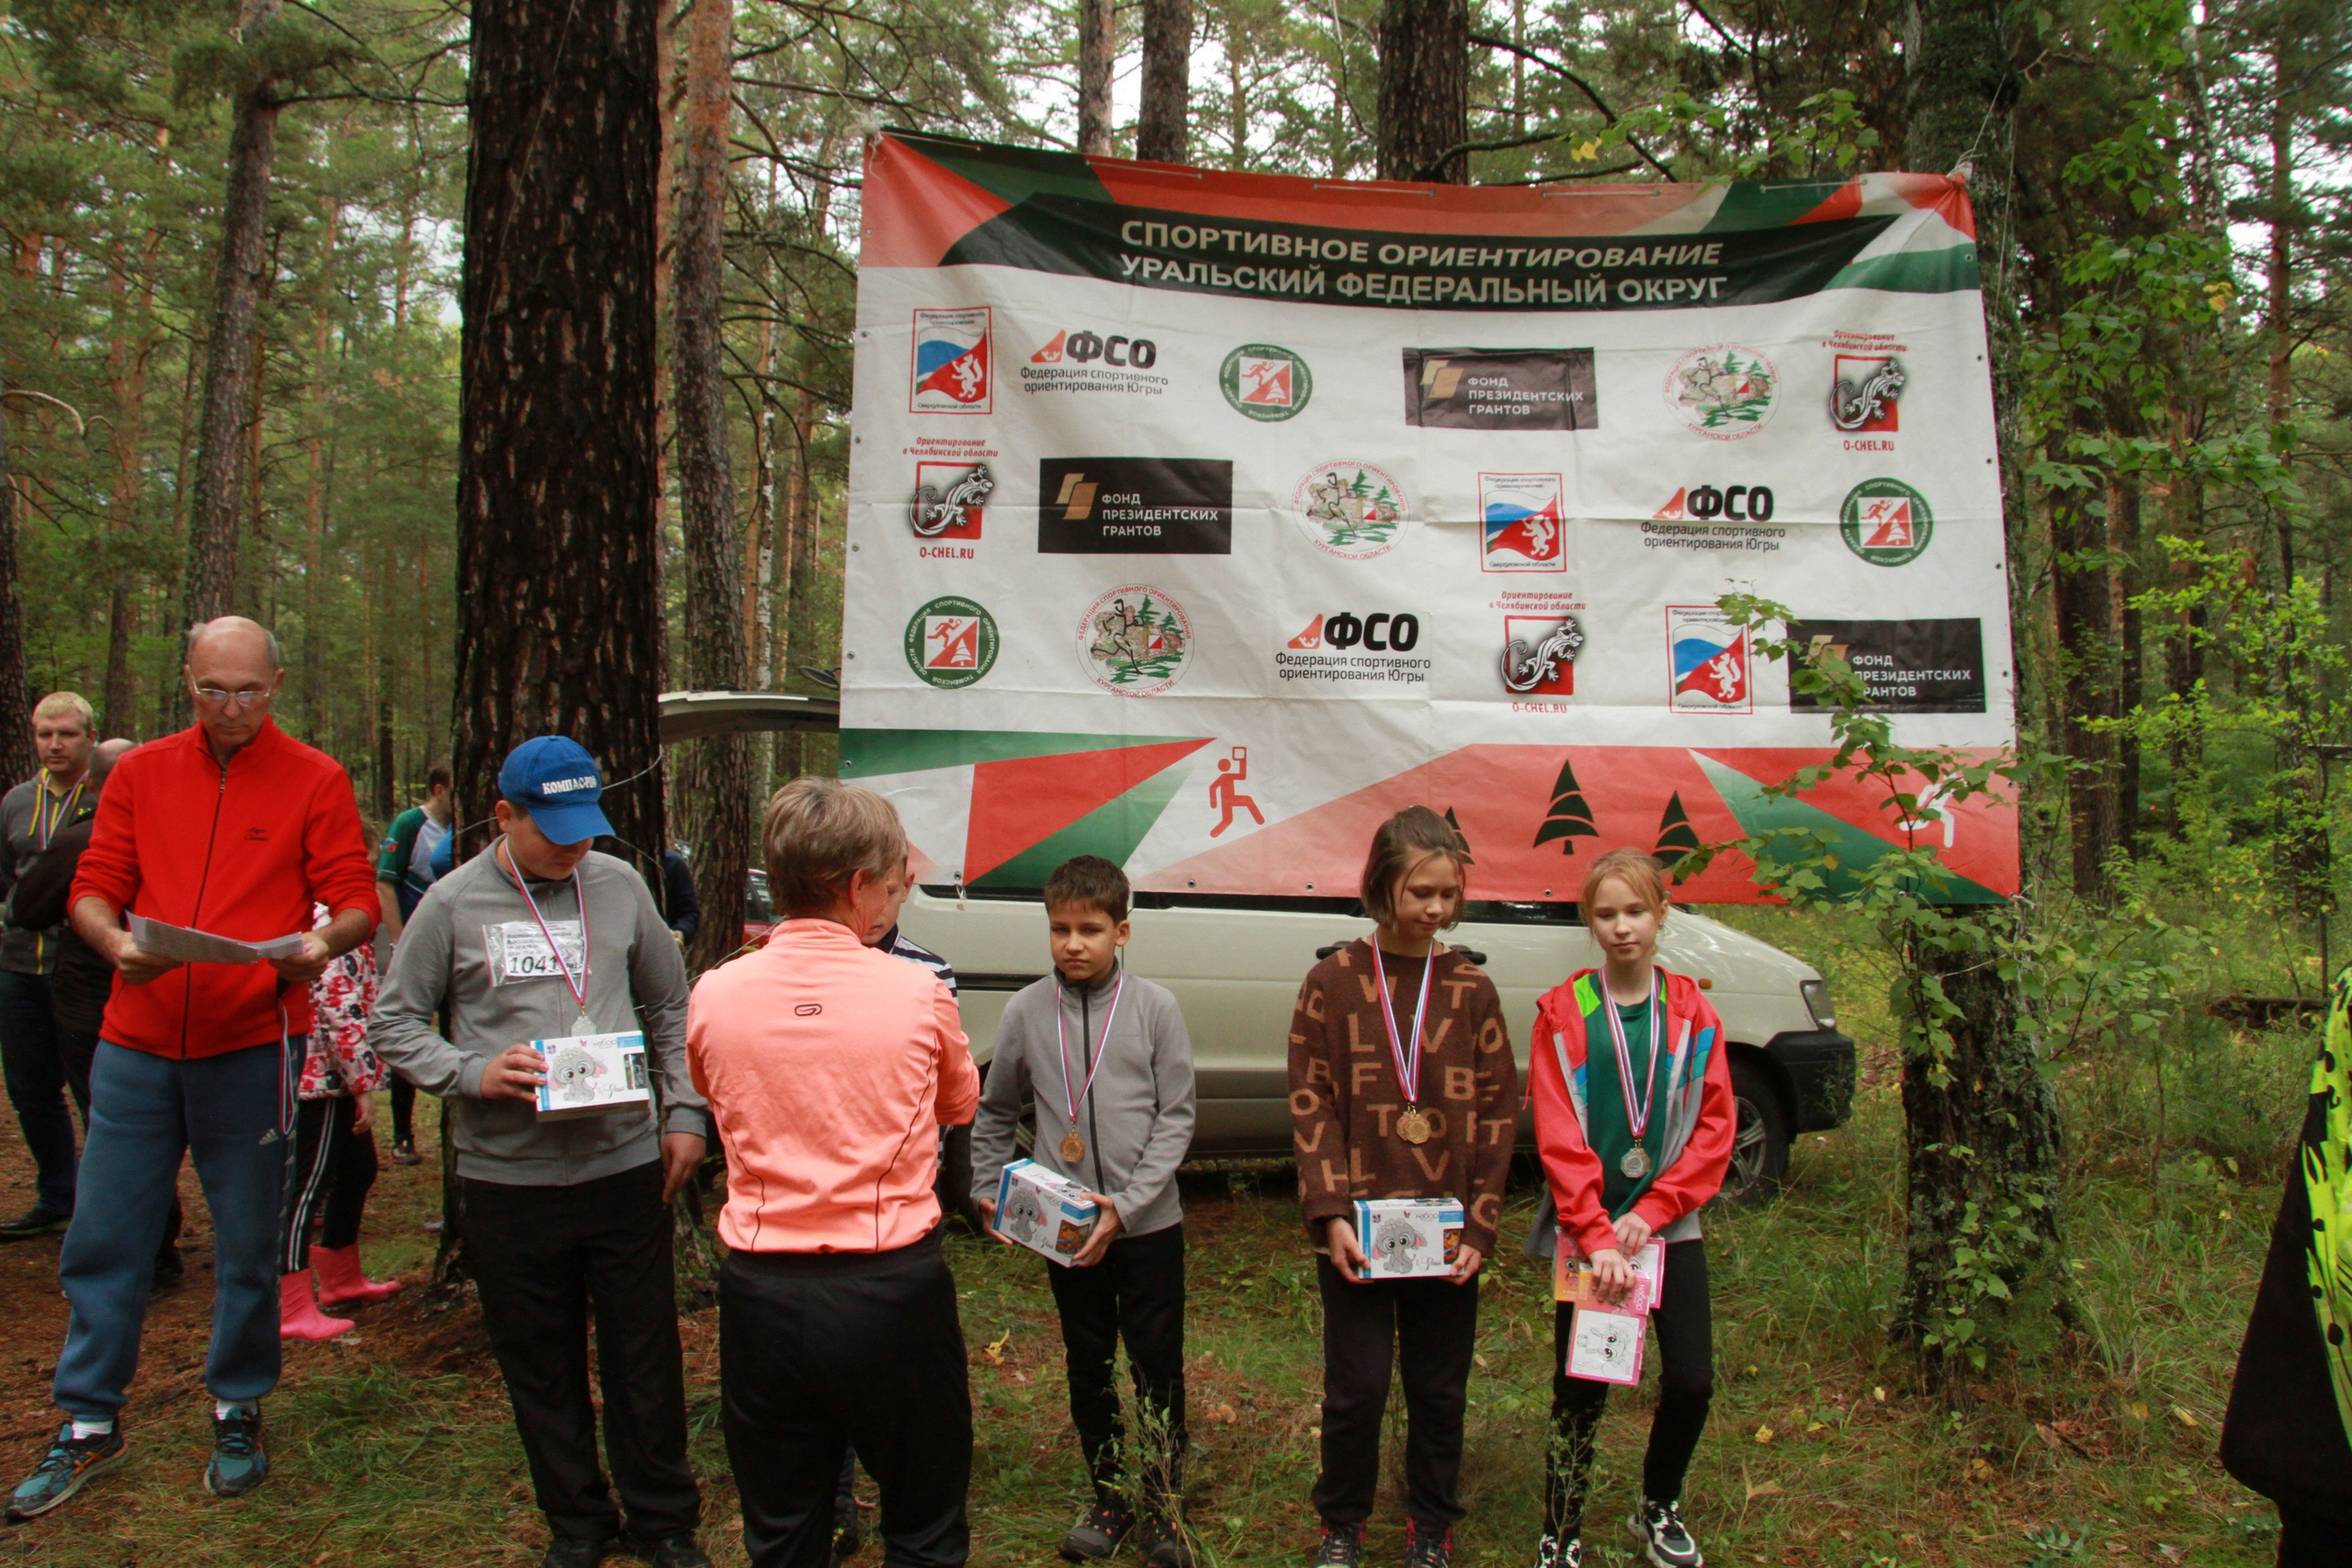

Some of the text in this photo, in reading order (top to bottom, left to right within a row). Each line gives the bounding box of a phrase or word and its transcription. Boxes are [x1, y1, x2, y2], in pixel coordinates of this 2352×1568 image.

[1120, 220, 1724, 268] СПОРТИВНОЕ ОРИЕНТИРОВАНИЕ
[1119, 254, 1729, 306] УРАЛЬСКИЙ ФЕДЕРАЛЬНЫЙ ОКРУГ
[1066, 329, 1157, 369] ФСО
[1021, 367, 1169, 387] Федерация спортивного
[1467, 376, 1509, 389] ФОНД
[1024, 381, 1163, 397] ориентирования Югры
[1468, 389, 1584, 403] ПРЕЗИДЕНТСКИХ
[1468, 403, 1531, 415] ГРАНТОВ
[1688, 423, 1762, 441] КУРГАНСКОЙ ОБЛАСТИ
[917, 436, 986, 447] Ориентирование
[1843, 440, 1894, 451] O-CHEL.RU
[910, 446, 961, 457] Челябинской
[964, 448, 999, 457] области
[1102, 493, 1141, 505] ФОНД
[1687, 484, 1774, 522] ФСО
[1102, 510, 1219, 522] ПРЕЗИДЕНТСКИХ
[1102, 525, 1161, 536] ГРАНТОВ
[1641, 521, 1786, 538] Федерация спортивного
[920, 546, 975, 559] O-CHEL.RU
[1314, 538, 1392, 560] КУРГАНСКОЙ ОБЛАСТИ
[1645, 537, 1780, 553] ориентирования Югры
[1501, 591, 1573, 602] Ориентирование
[1078, 586, 1192, 640] ФЕДЕРАЦИЯ СПОРТИВНОГО ОРИЕНТИРОВАНИЯ
[1496, 601, 1548, 610] Челябинской
[1550, 602, 1587, 610] области
[909, 607, 932, 643] ФЕДЕРАЦИЯ
[934, 600, 981, 615] СПОРТИВНОГО
[1324, 612, 1419, 652] ФСО
[909, 648, 928, 676] ОБЛАСТИ
[1275, 652, 1431, 670] Федерация спортивного
[1852, 655, 1894, 667] ФОНД
[1279, 669, 1424, 684] ориентирования Югры
[1096, 677, 1174, 698] КУРГАНСКОЙ ОБЛАСТИ
[1864, 686, 1917, 696] РАНТОВ
[1511, 702, 1567, 714] O-CHEL.RU
